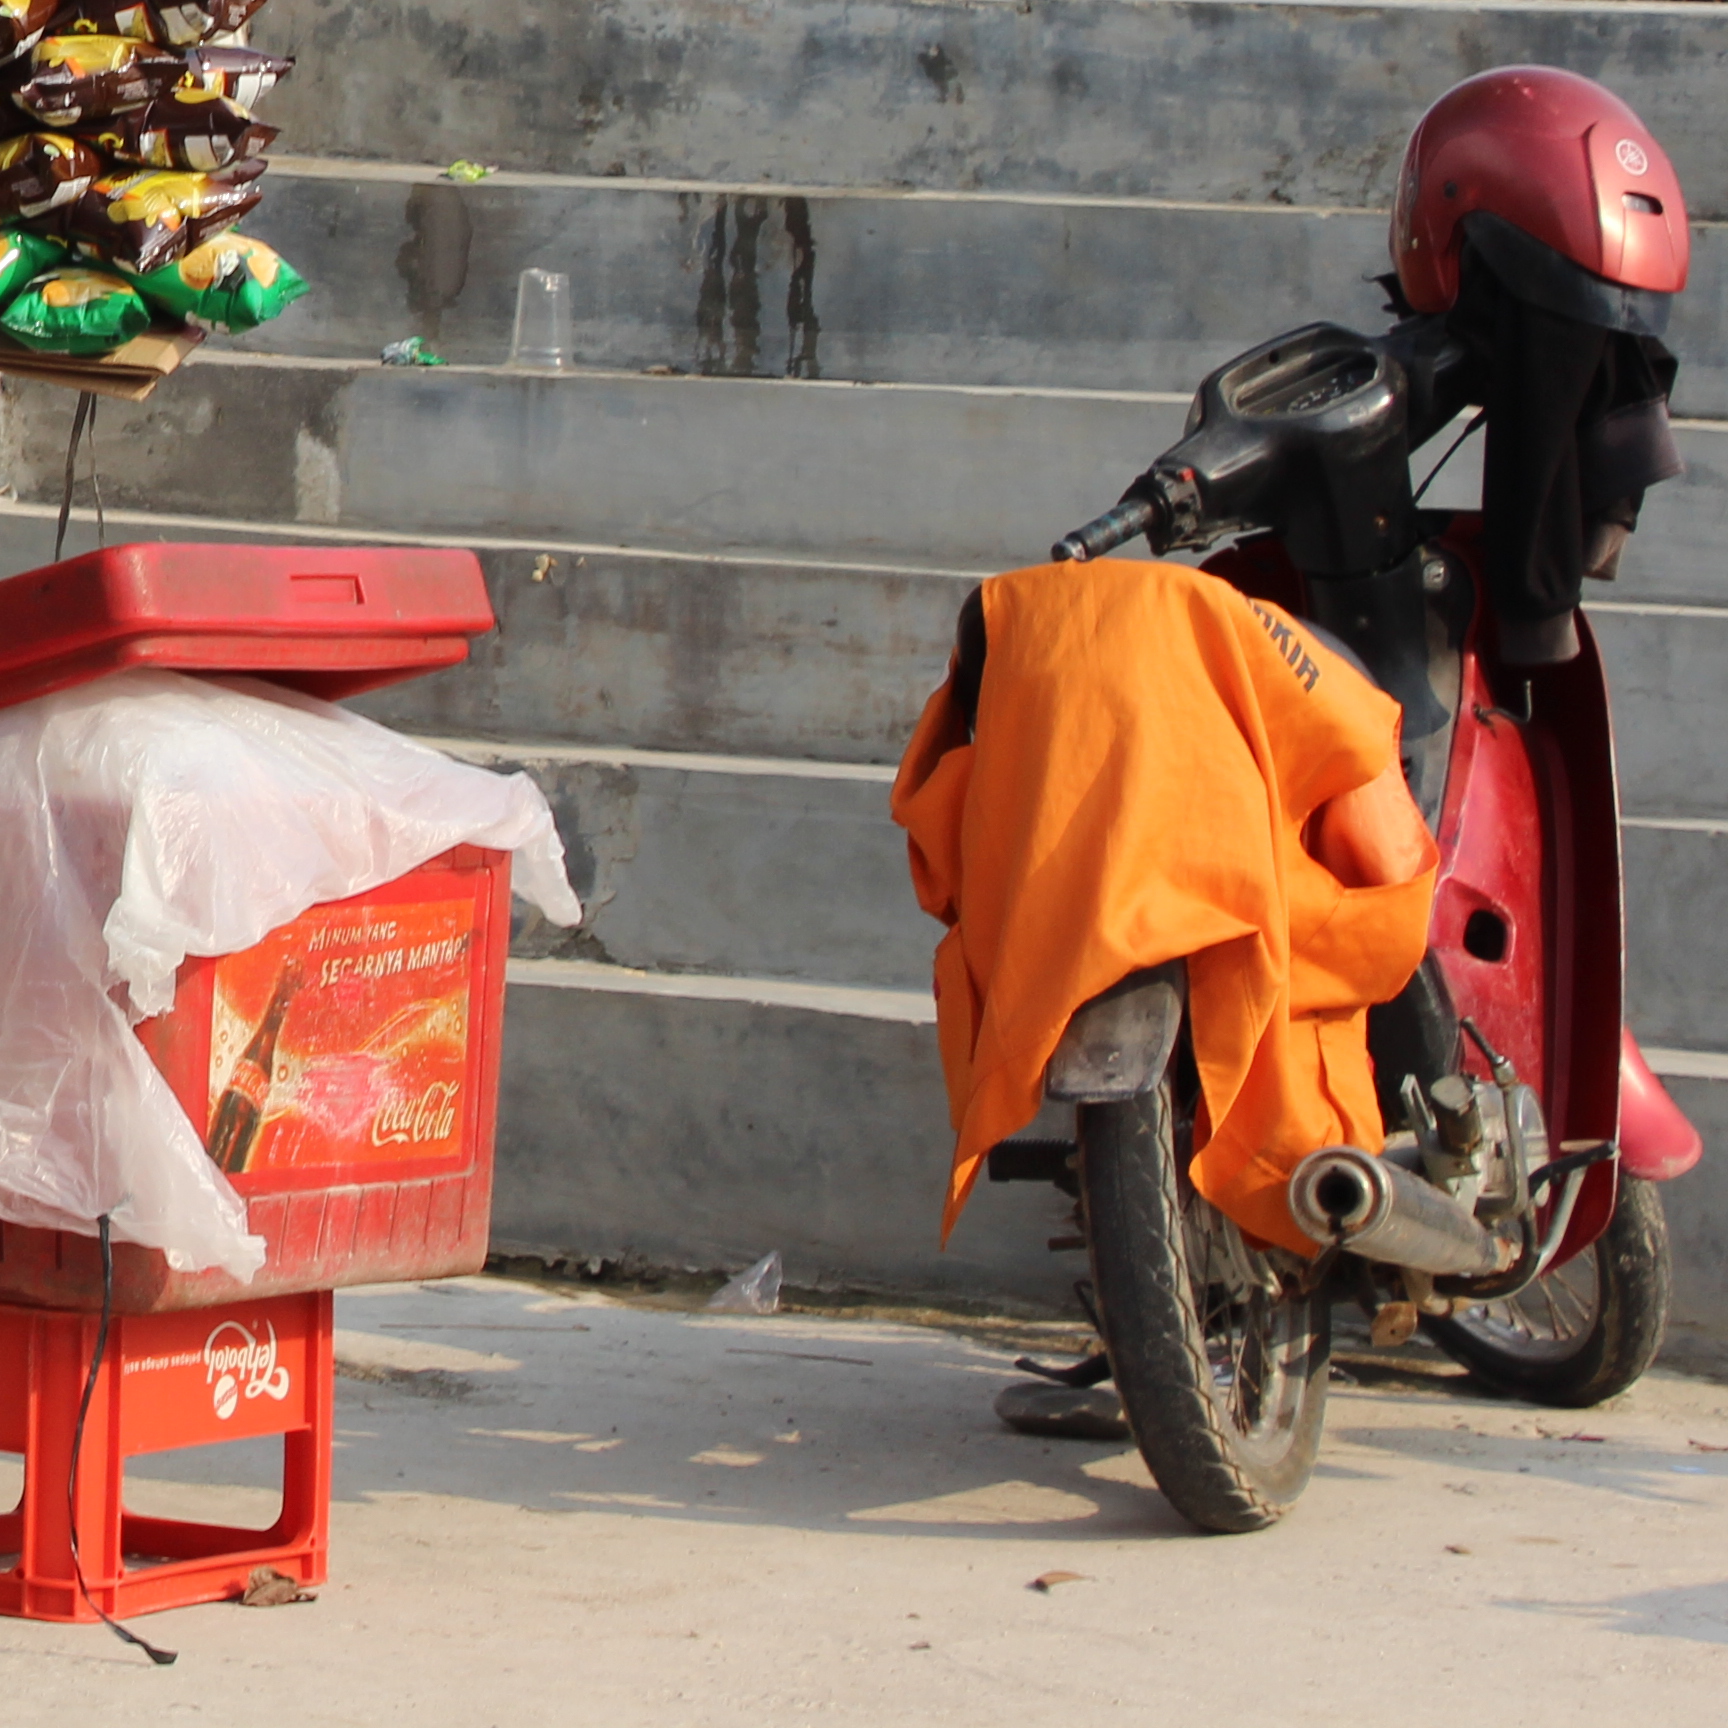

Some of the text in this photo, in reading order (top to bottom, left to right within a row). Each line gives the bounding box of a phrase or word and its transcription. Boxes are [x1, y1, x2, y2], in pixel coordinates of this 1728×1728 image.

[307, 921, 398, 953] MINUM YANG
[371, 1079, 461, 1148] Coca-Cola
[202, 1317, 292, 1402] Tehbotol
